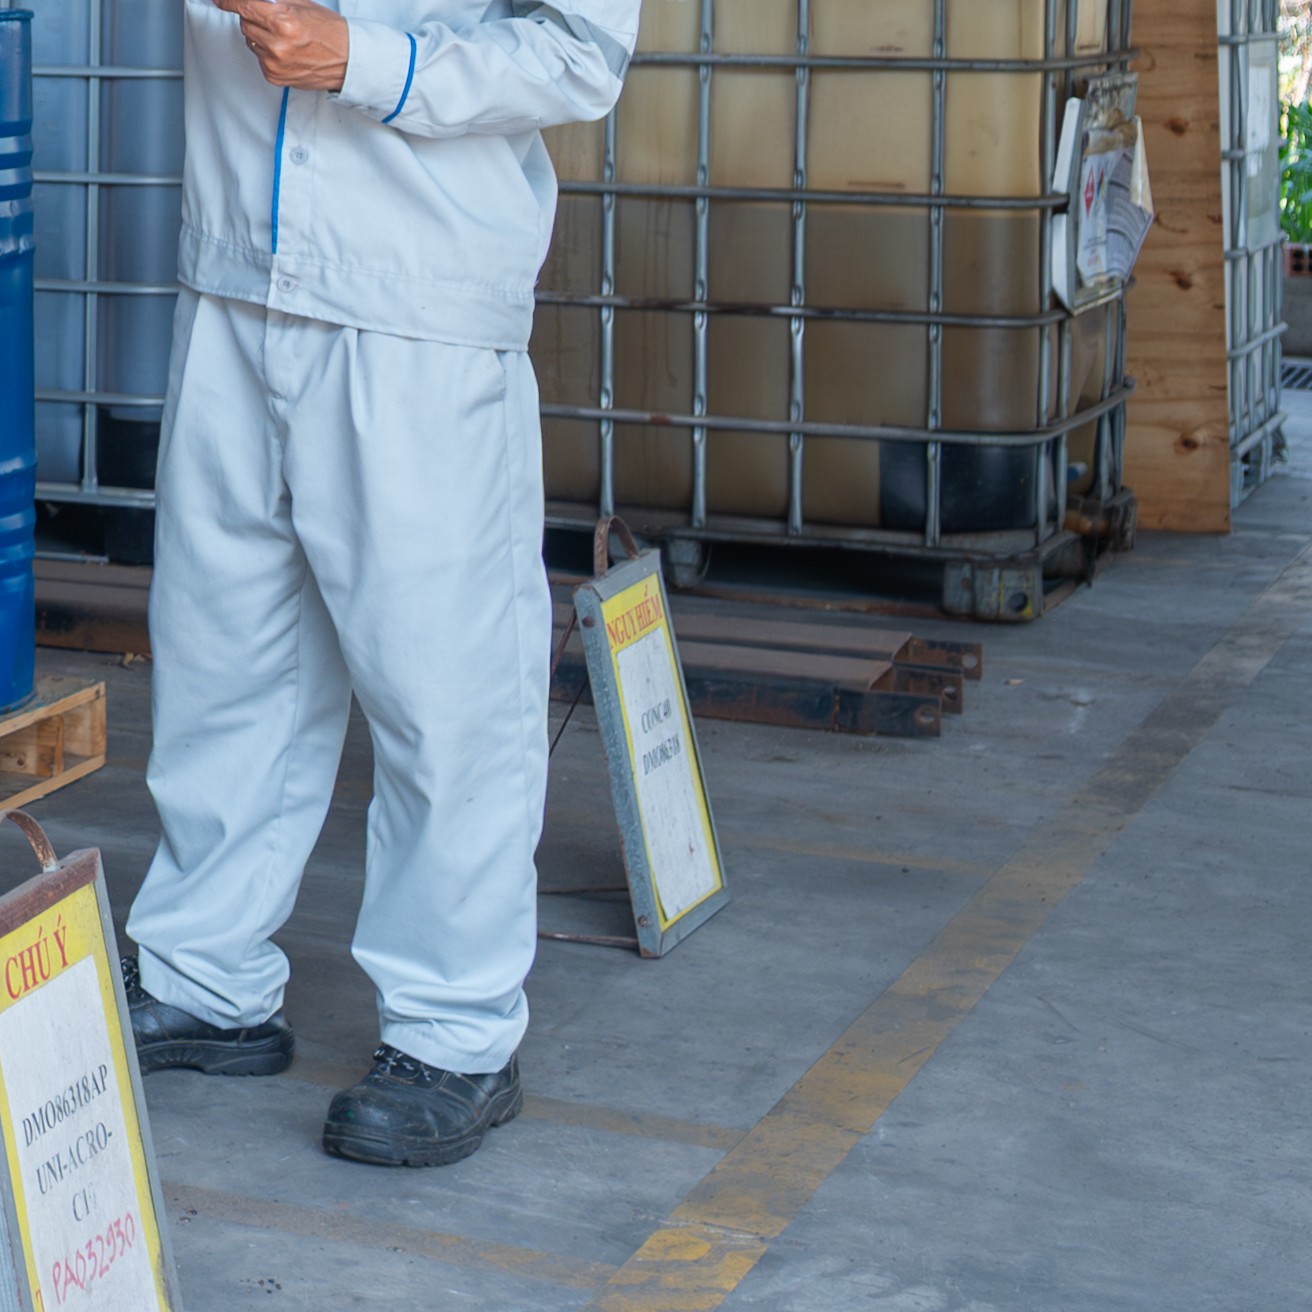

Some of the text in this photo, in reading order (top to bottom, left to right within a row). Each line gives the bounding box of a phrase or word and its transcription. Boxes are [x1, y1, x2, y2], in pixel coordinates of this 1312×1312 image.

[606, 607, 637, 650] NGUY
[5, 914, 68, 1000] CHÚ Ý
[36, 1126, 113, 1195] UNI-ACRO-
